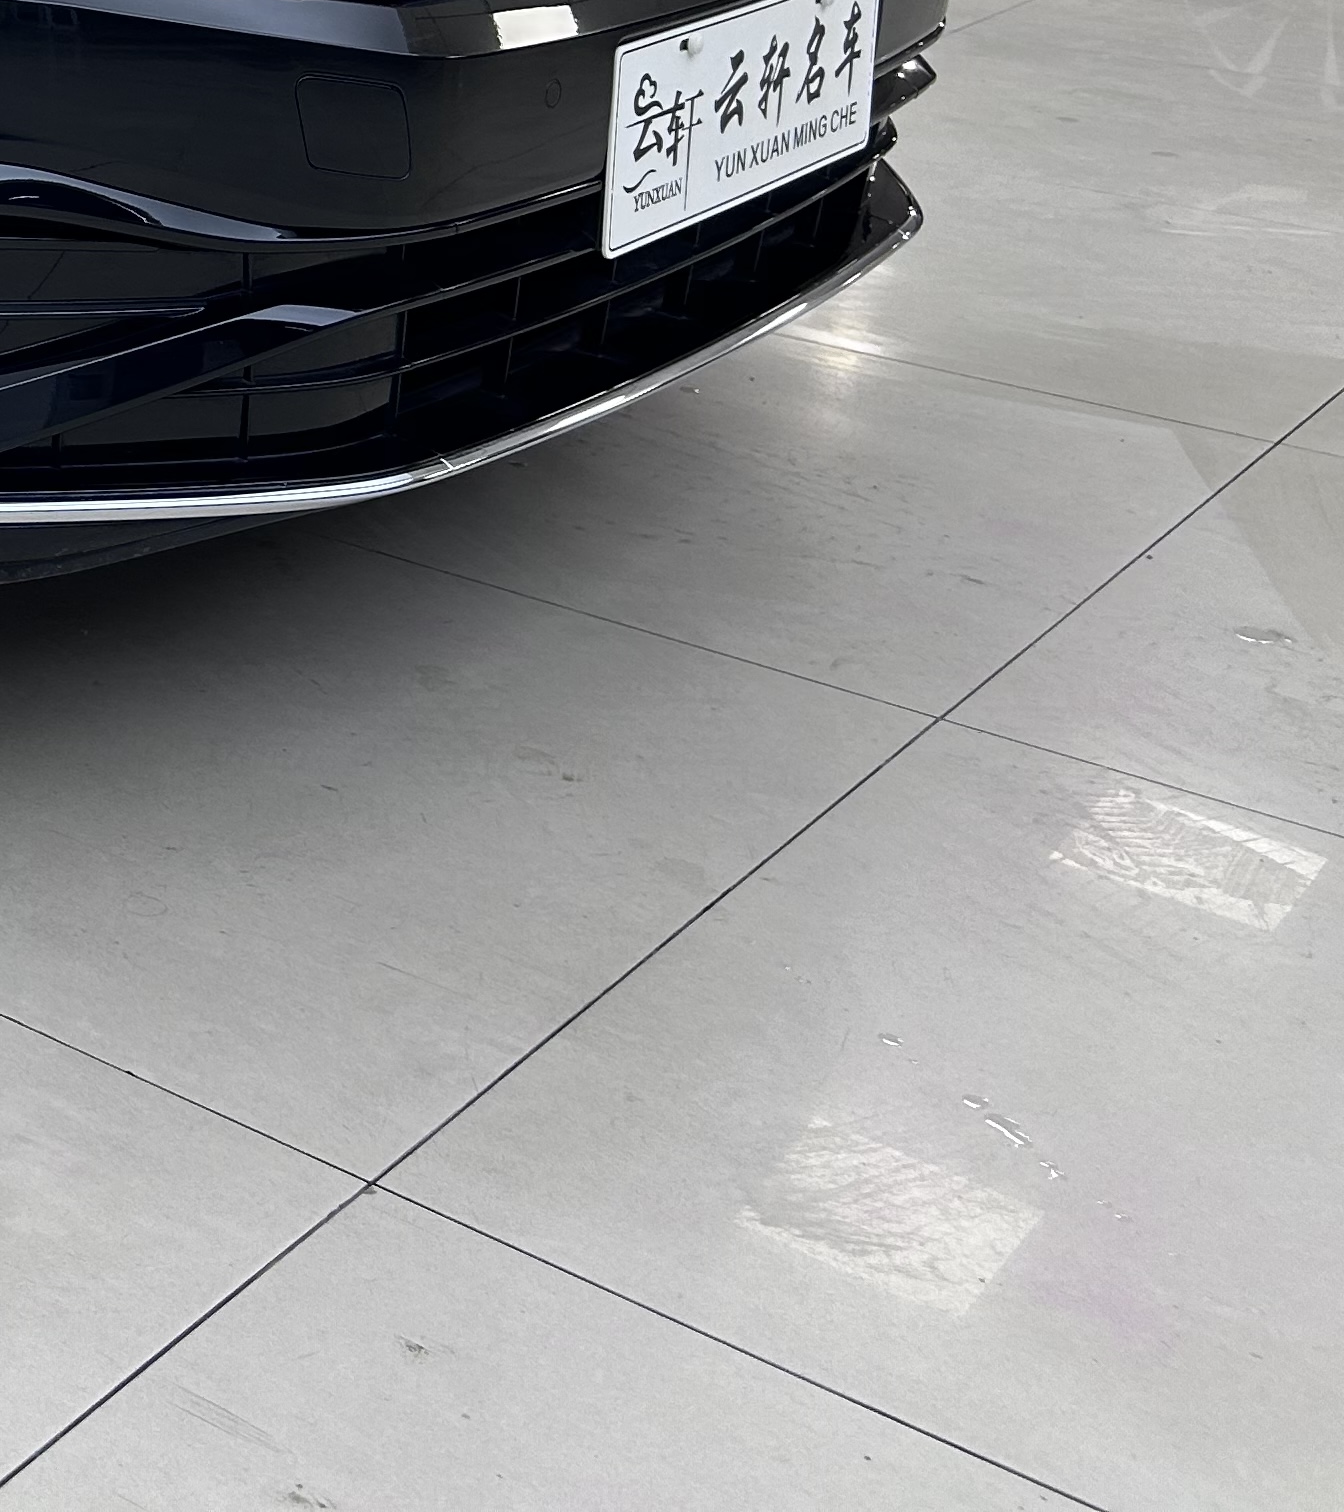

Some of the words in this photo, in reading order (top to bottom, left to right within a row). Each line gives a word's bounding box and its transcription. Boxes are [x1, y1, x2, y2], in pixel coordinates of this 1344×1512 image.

[714, 1, 863, 134] 云轩名车
[714, 148, 748, 182] YUN
[749, 130, 791, 169] XUAN
[792, 115, 828, 149] MING
[830, 101, 858, 134] CHE
[633, 177, 683, 213] YUNXUAN
